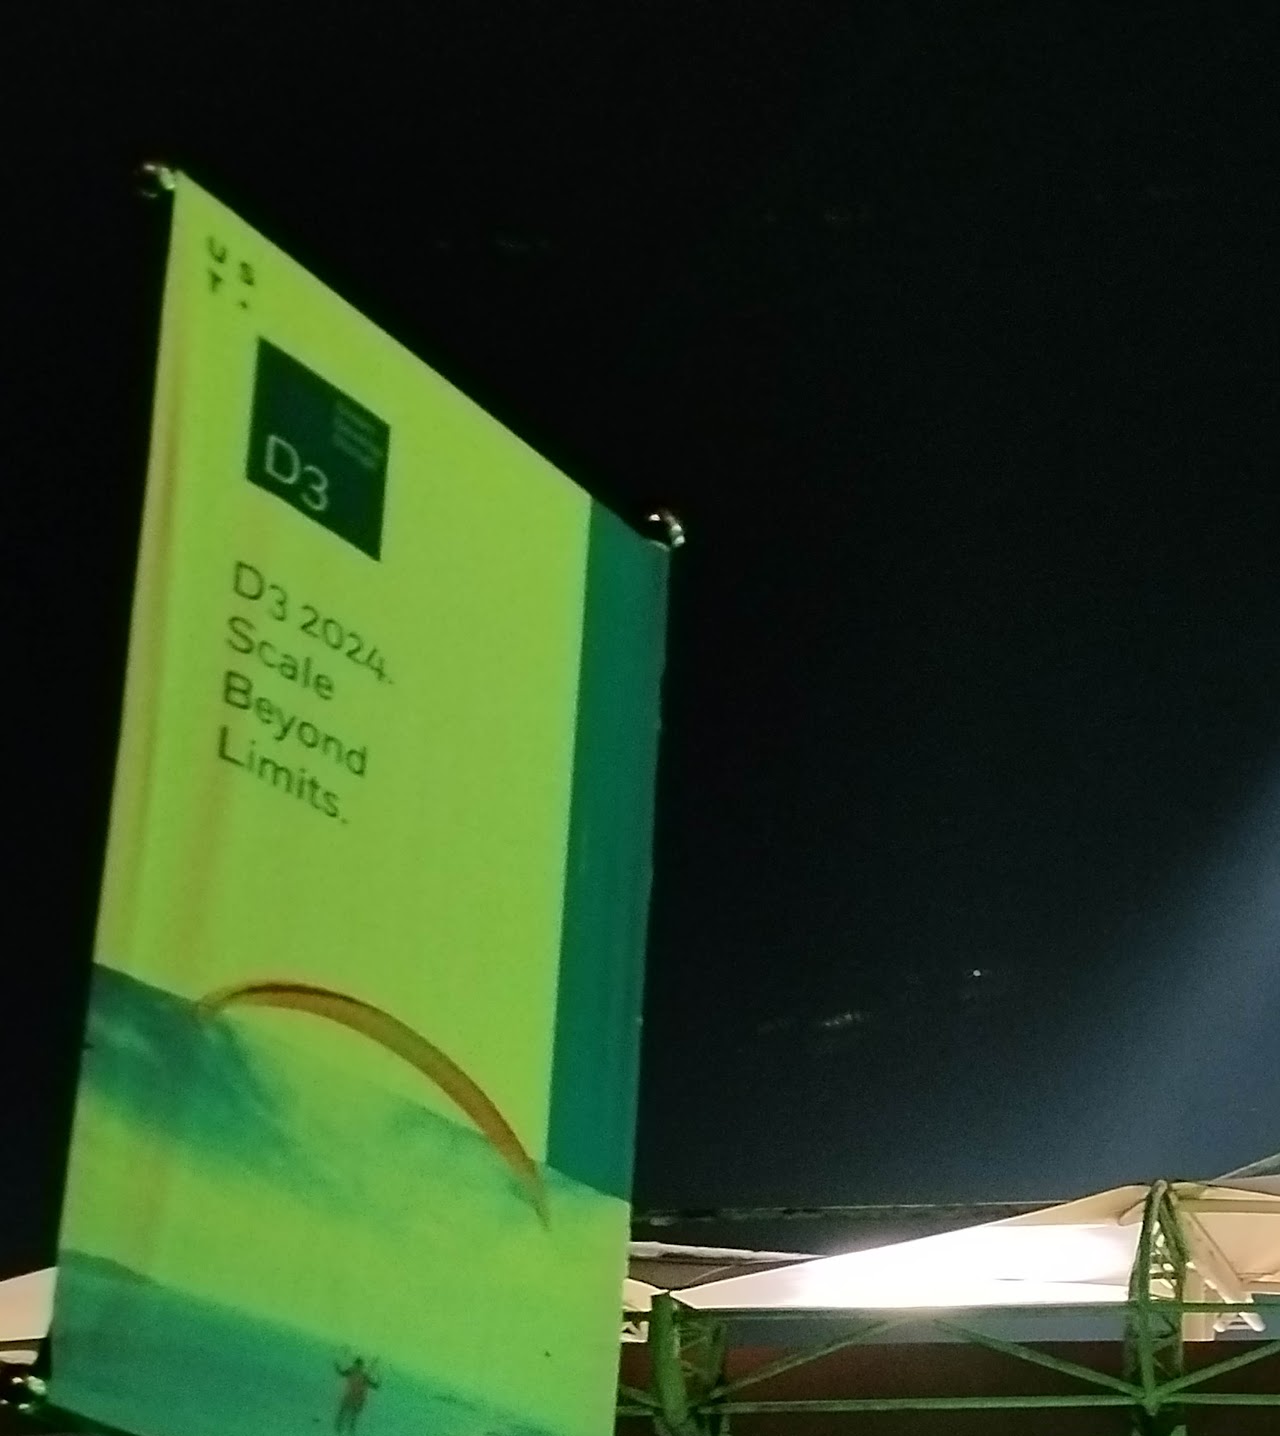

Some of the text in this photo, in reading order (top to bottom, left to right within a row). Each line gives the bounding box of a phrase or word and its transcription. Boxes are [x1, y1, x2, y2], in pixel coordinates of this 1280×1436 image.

[266, 435, 328, 511] D3
[233, 560, 288, 622] D3
[226, 615, 335, 701] Scale
[224, 670, 368, 777] Beyond
[218, 725, 348, 826] Limits.
